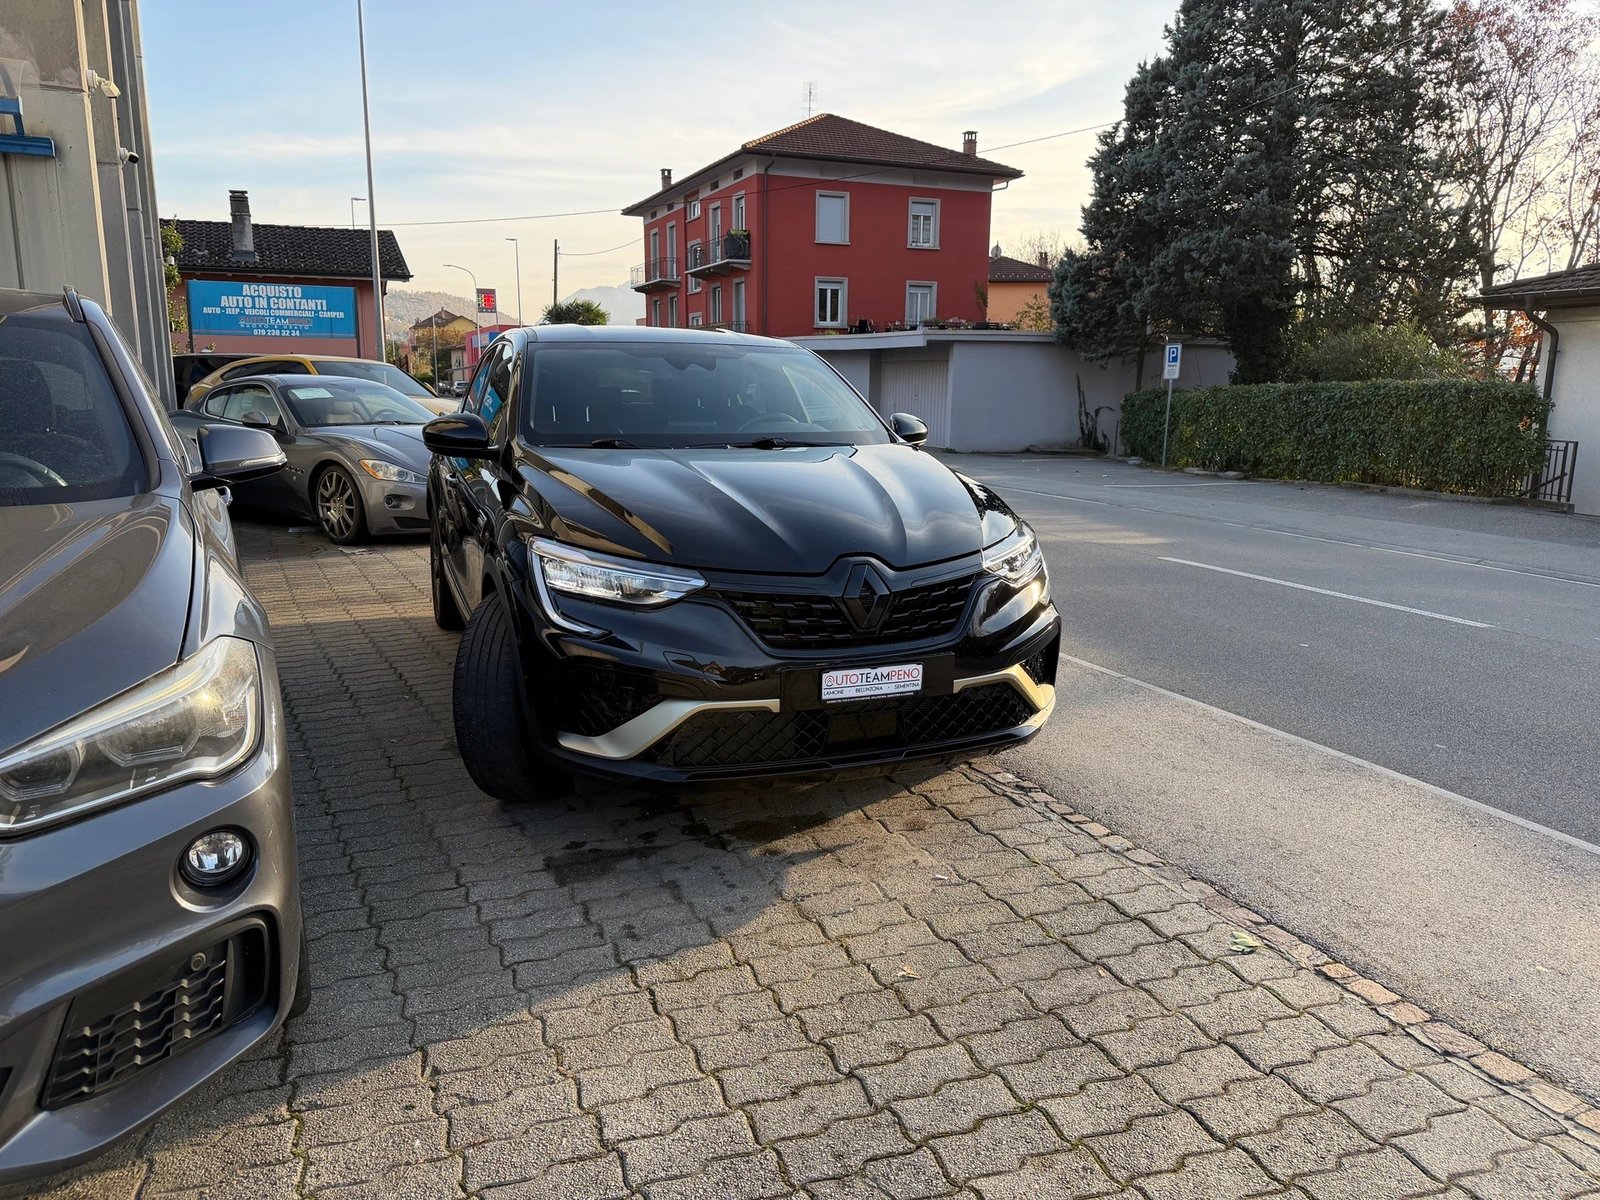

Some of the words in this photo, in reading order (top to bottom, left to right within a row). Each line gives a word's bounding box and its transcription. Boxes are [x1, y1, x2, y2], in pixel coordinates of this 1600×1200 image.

[242, 284, 302, 298] ACQUISTO
[220, 295, 253, 309] AUTO
[255, 297, 265, 309] IN
[270, 298, 327, 311] CONTANTI
[270, 310, 315, 318] COMMERCIALI
[319, 311, 345, 319] CAMPER
[291, 330, 300, 338] 34
[1170, 348, 1177, 362] P
